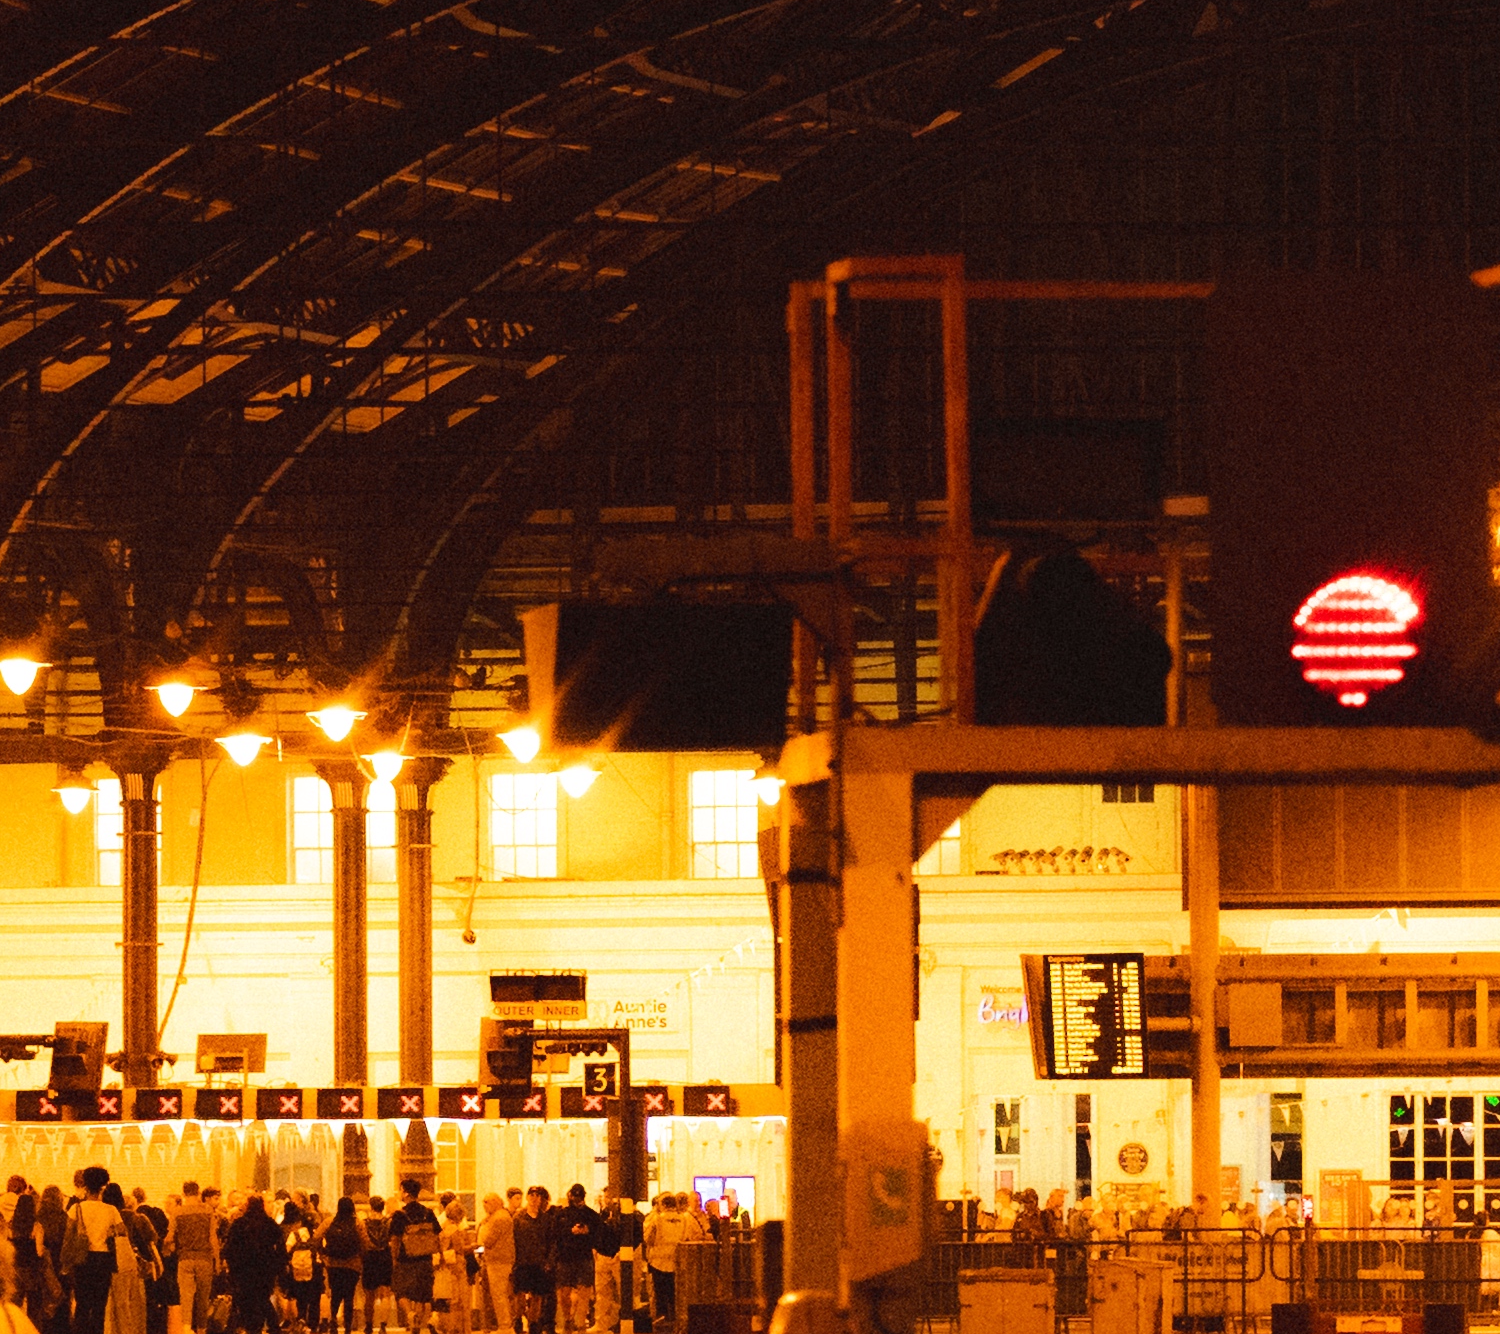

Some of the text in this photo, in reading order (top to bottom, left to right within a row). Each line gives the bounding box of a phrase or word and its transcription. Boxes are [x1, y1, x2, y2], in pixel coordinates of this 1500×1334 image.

[981, 985, 1022, 994] Welcome
[493, 1006, 579, 1016] OUTER INNER
[593, 1068, 608, 1092] 3
